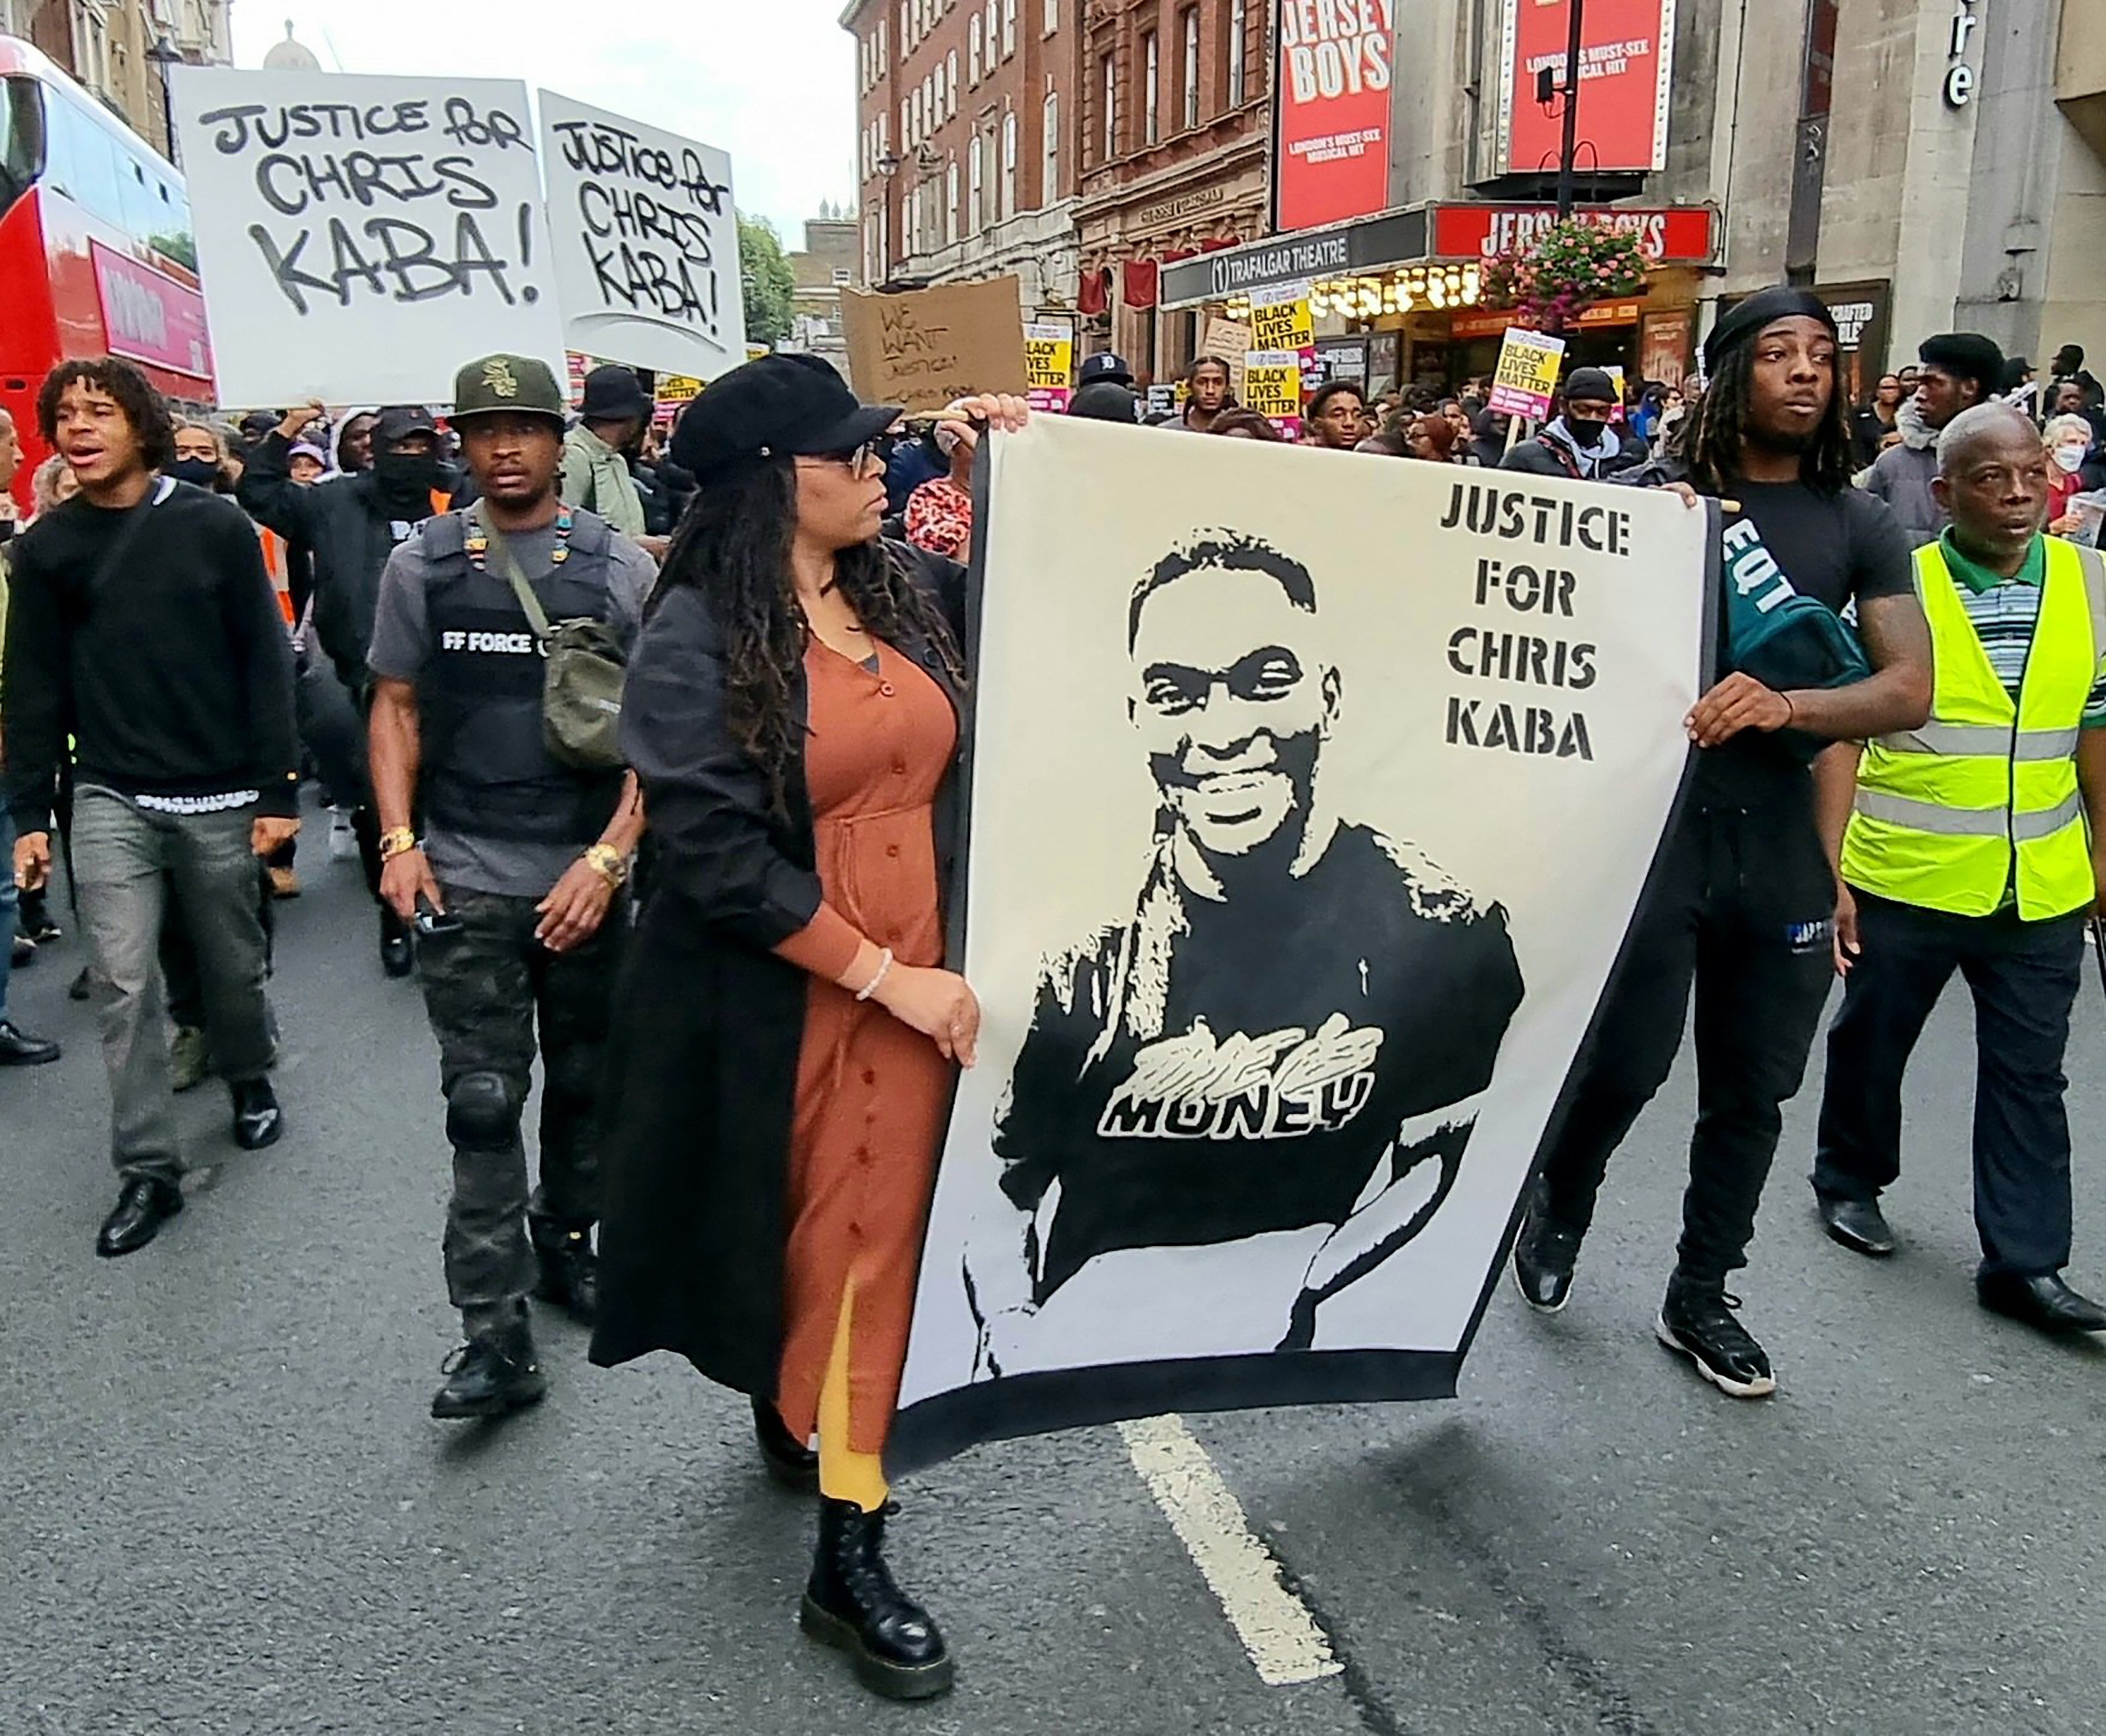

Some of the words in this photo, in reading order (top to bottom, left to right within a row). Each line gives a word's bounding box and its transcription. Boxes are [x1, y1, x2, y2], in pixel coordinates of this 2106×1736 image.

[1289, 33, 1390, 105] BOYS
[199, 101, 429, 154] JUSTICE
[256, 151, 498, 215] CHRIS
[579, 181, 711, 267] CHRIS
[249, 202, 539, 316] KABA!
[1231, 250, 1291, 283] TRAFALGAR
[1292, 238, 1347, 270] THEATRE
[582, 231, 717, 336] KABA!
[1255, 304, 1297, 322] BLACK
[1256, 319, 1293, 338] LIVES
[1258, 330, 1311, 350] MATTER
[1026, 342, 1056, 355] LACK
[1505, 344, 1547, 365] BLACK
[1028, 371, 1065, 385] ATTER
[1247, 369, 1287, 383] BLACK
[1502, 357, 1537, 376] LIVES
[1247, 385, 1281, 399] LIVES
[1498, 370, 1550, 394] MATTER
[1247, 400, 1296, 414] MATTER
[1440, 483, 1630, 556] JUSTICE
[1475, 558, 1576, 617] FOR
[468, 632, 532, 653] FORCE
[1447, 627, 1597, 689] CHRIS
[1445, 697, 1594, 761] KABA
